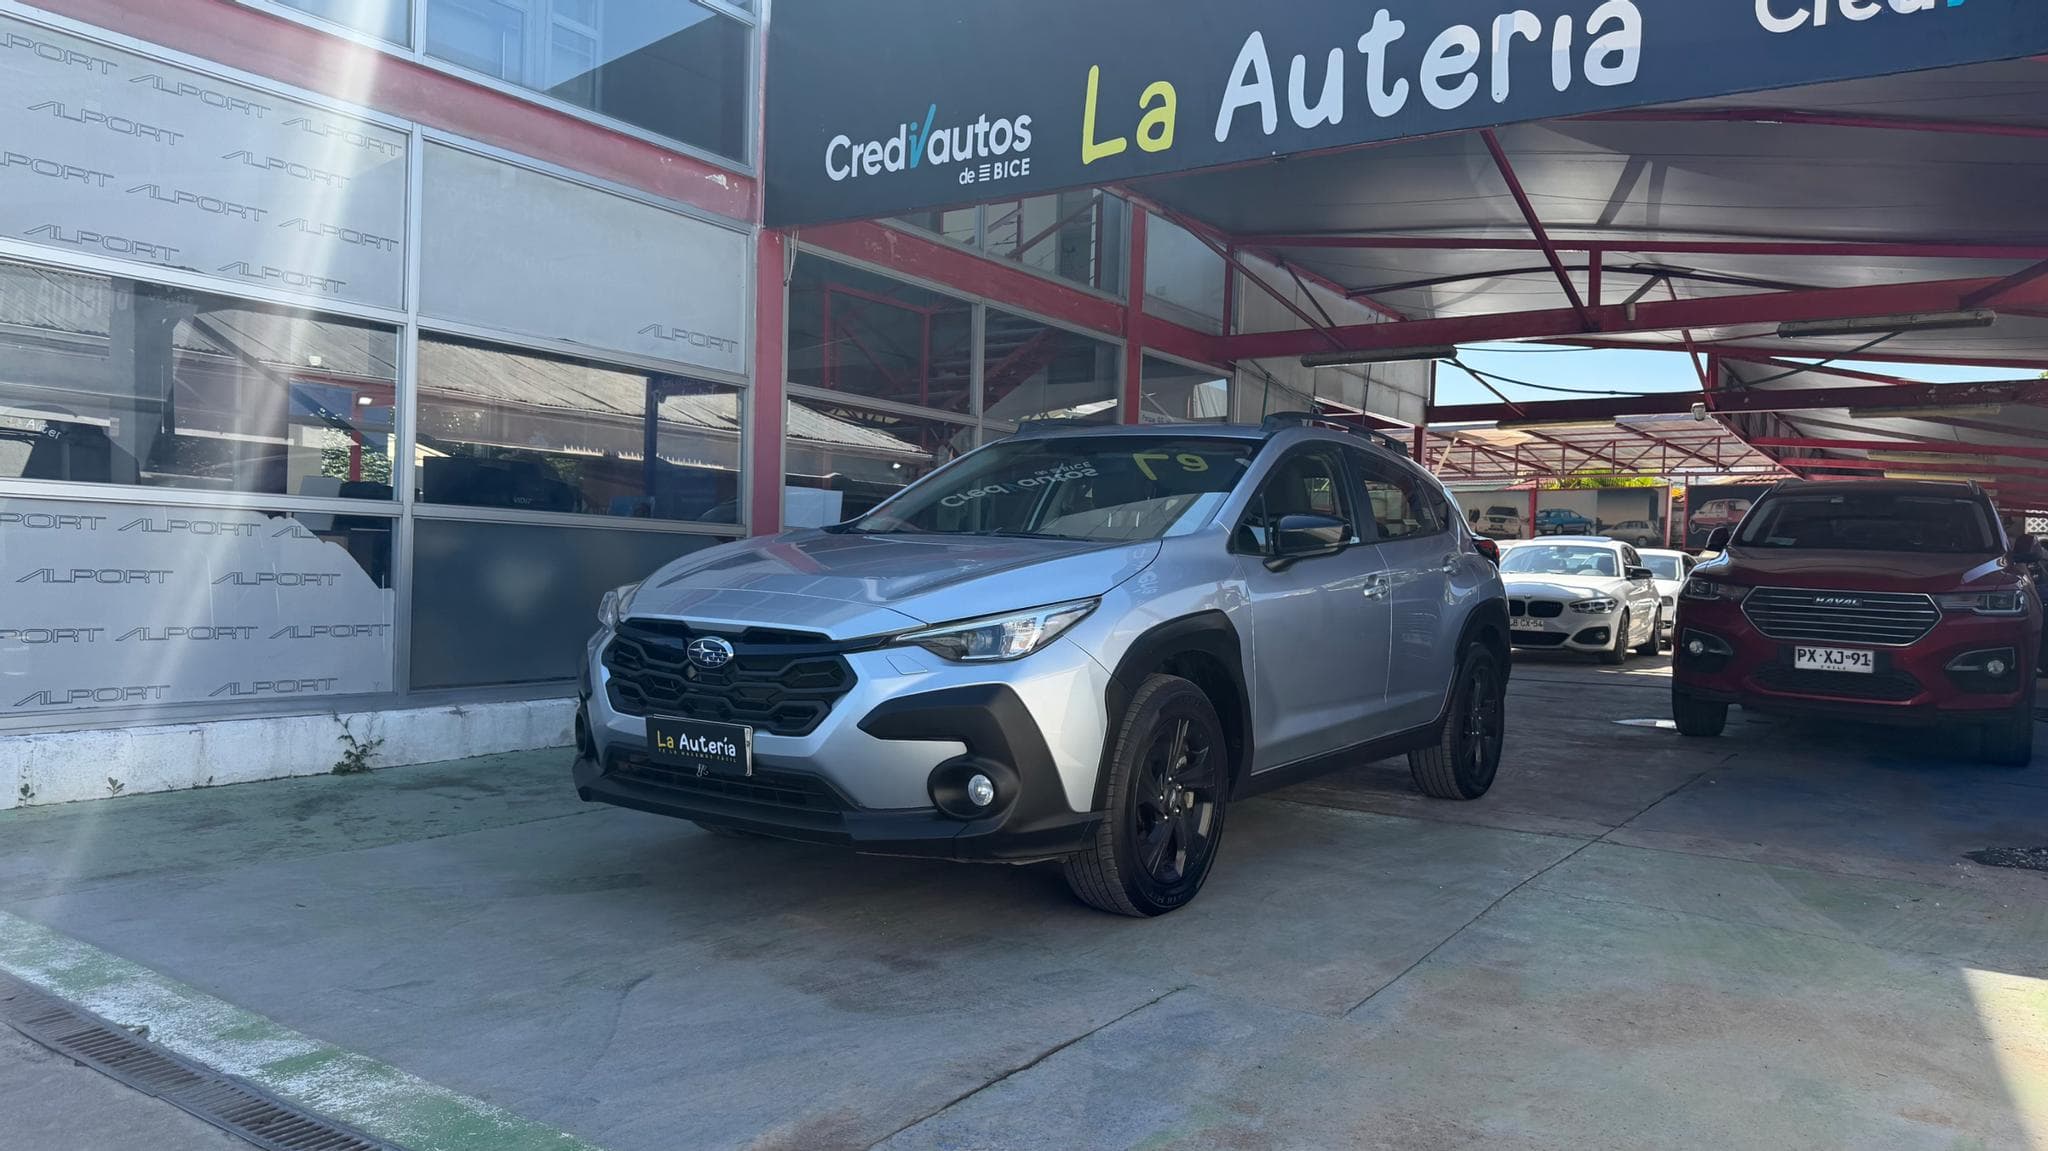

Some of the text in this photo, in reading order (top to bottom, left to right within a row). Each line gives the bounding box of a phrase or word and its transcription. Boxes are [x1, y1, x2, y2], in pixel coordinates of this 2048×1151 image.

[129, 73, 272, 119] ALPORT
[27, 101, 184, 146] ALPORT
[1082, 64, 1177, 165] La
[959, 157, 1031, 185] de BICE
[117, 518, 262, 538] ALPORT
[16, 568, 174, 585] ALPORT
[212, 572, 341, 587] ALPORT
[115, 626, 258, 642] ALPORT
[268, 624, 391, 640] ALPORT
[13, 684, 171, 708] ALPORT
[208, 677, 338, 697] ALPORT
[657, 730, 736, 757] La Autería
